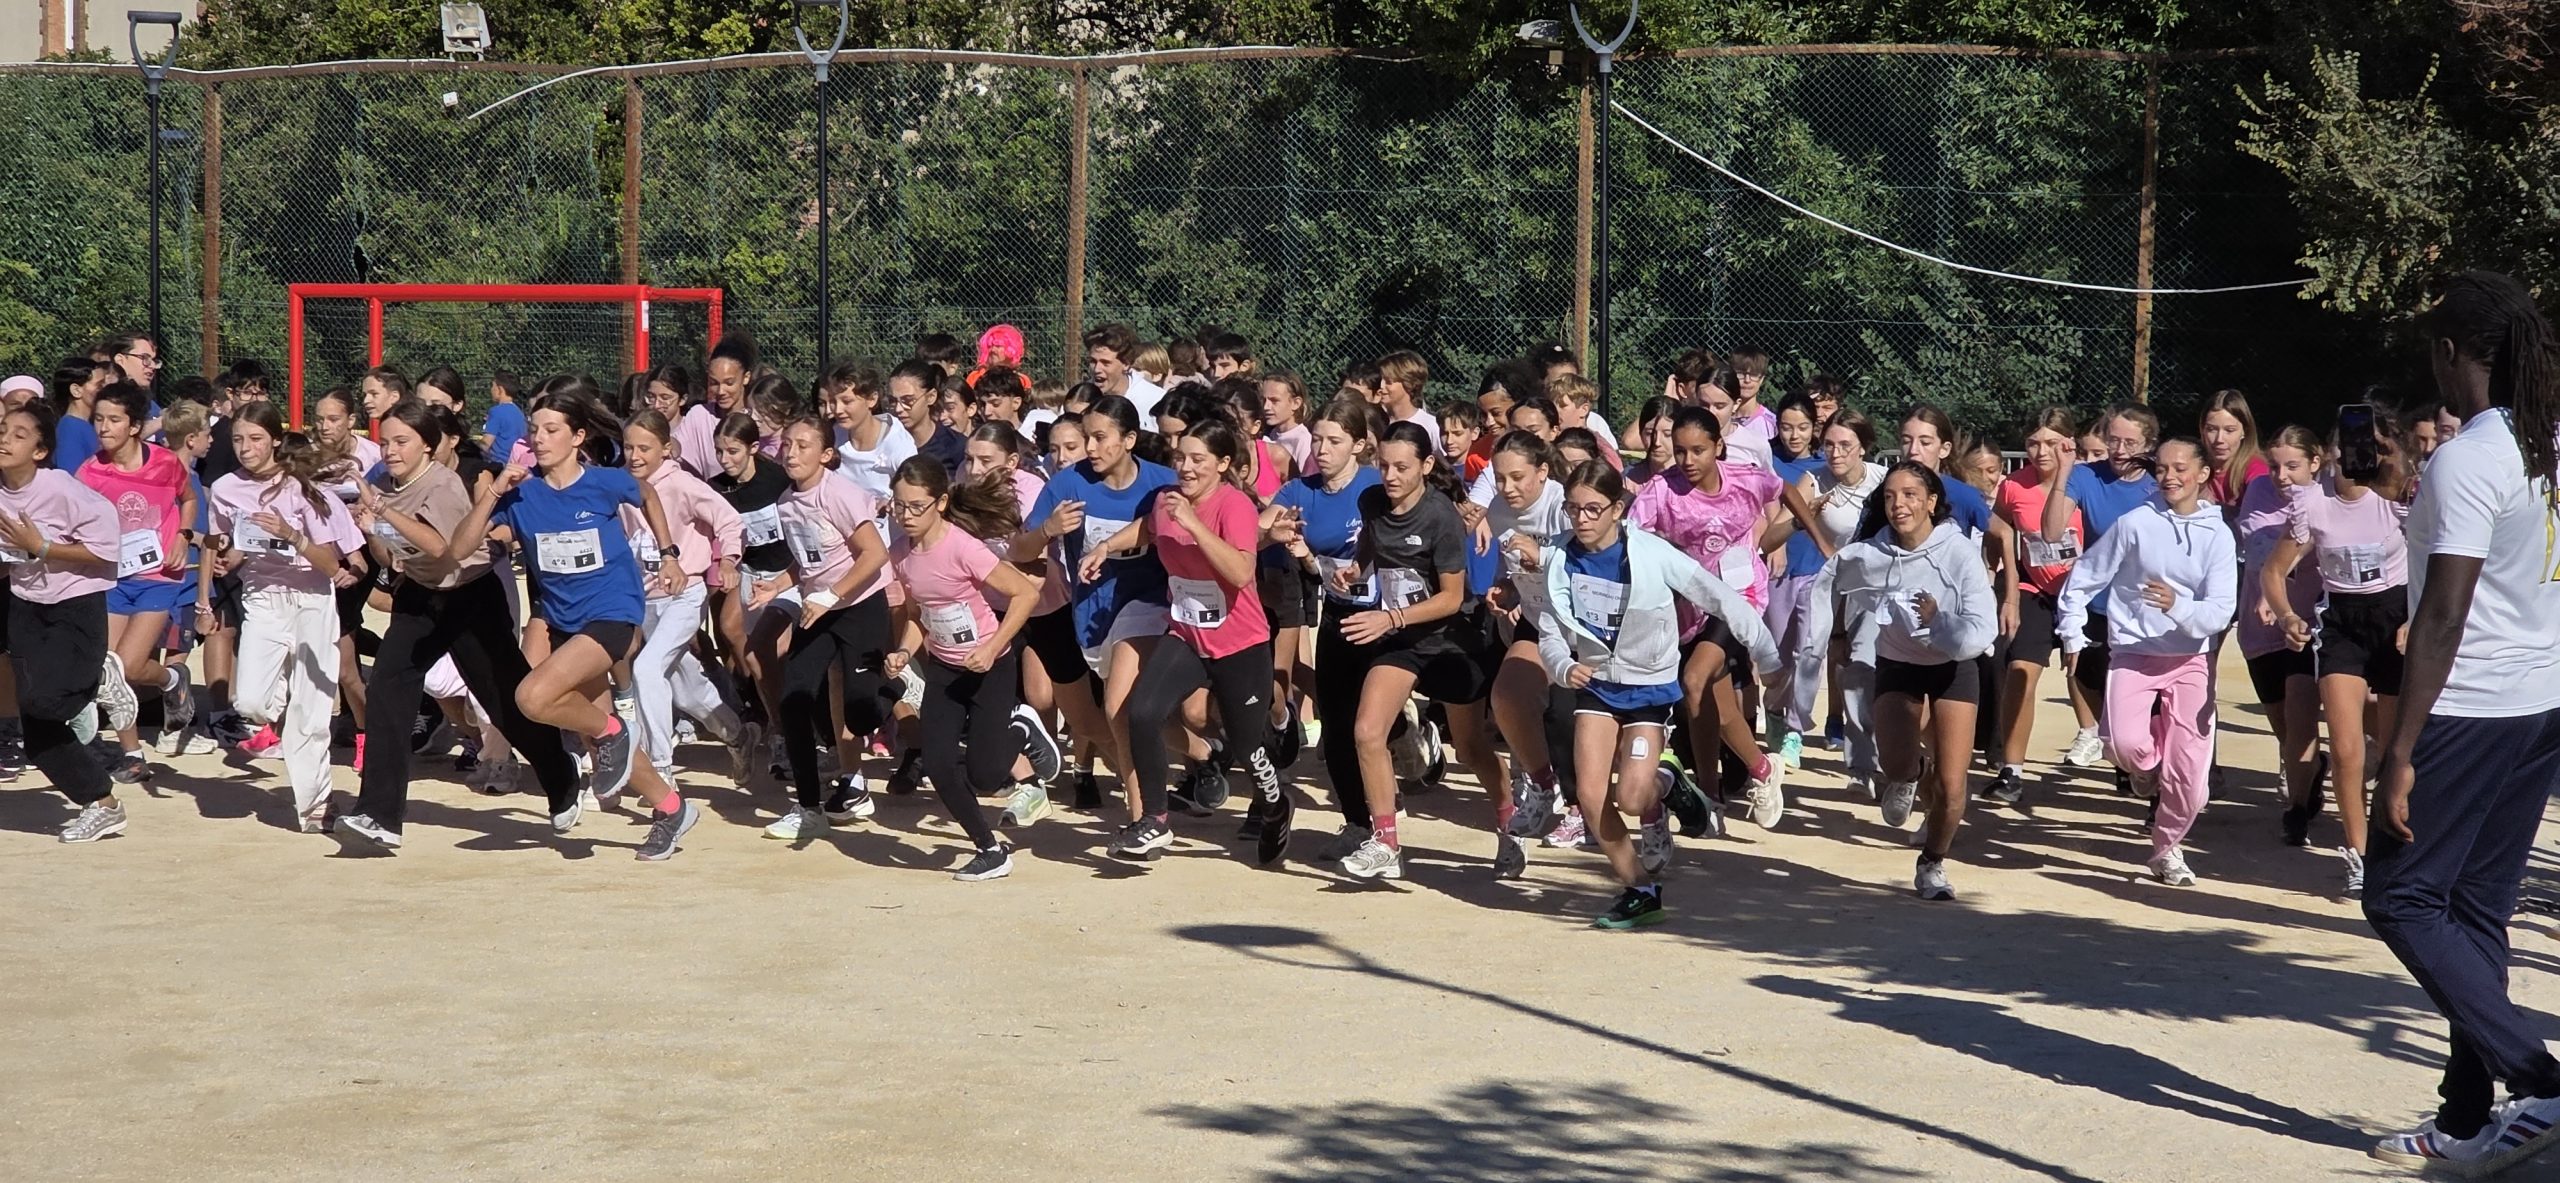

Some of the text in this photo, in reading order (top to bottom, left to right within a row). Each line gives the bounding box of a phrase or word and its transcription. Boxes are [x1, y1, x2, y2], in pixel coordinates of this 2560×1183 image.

[145, 554, 151, 562] F
[582, 556, 588, 565] F
[2367, 572, 2374, 580] F
[1413, 594, 1420, 602] F
[1206, 612, 1212, 621] F
[960, 633, 967, 642] F
[1250, 746, 1280, 803] adidas
